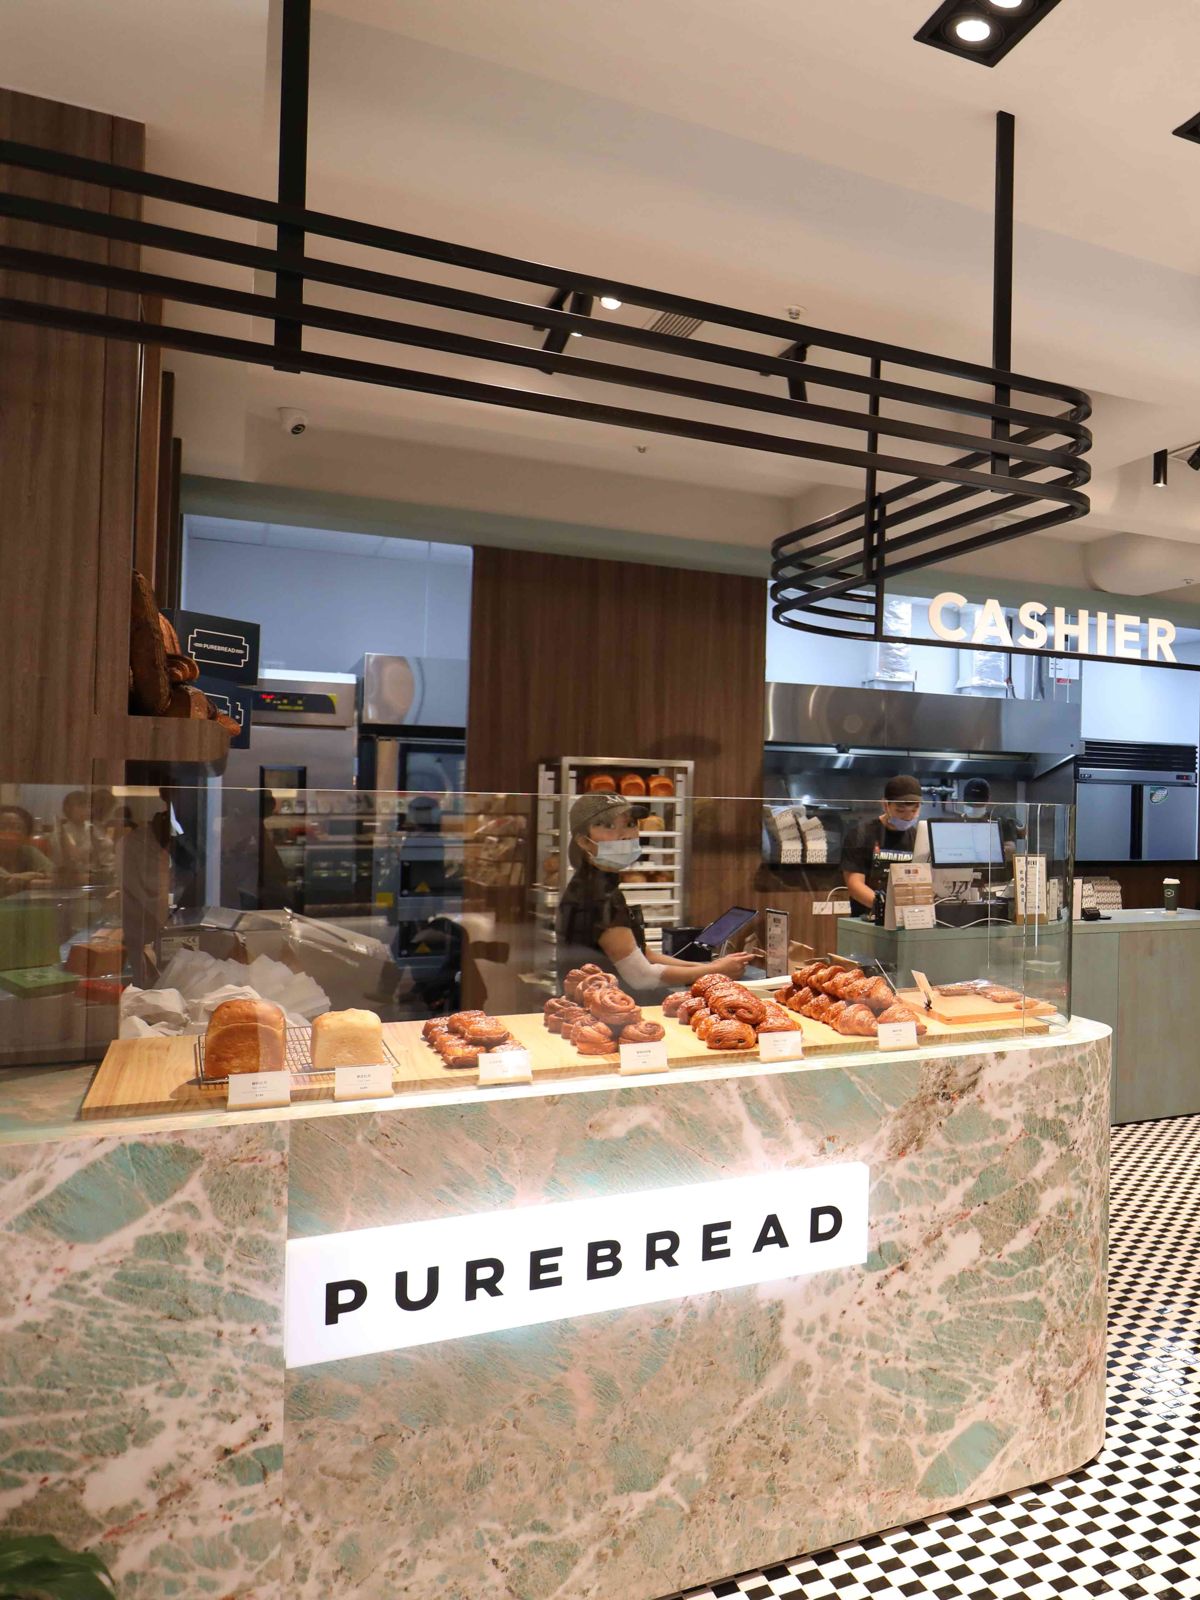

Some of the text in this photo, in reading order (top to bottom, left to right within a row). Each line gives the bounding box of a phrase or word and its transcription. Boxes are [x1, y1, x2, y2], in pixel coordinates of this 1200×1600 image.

[203, 643, 236, 654] PUREBREAD
[928, 591, 1178, 663] CASHIER
[324, 1204, 844, 1326] PUREBREAD
